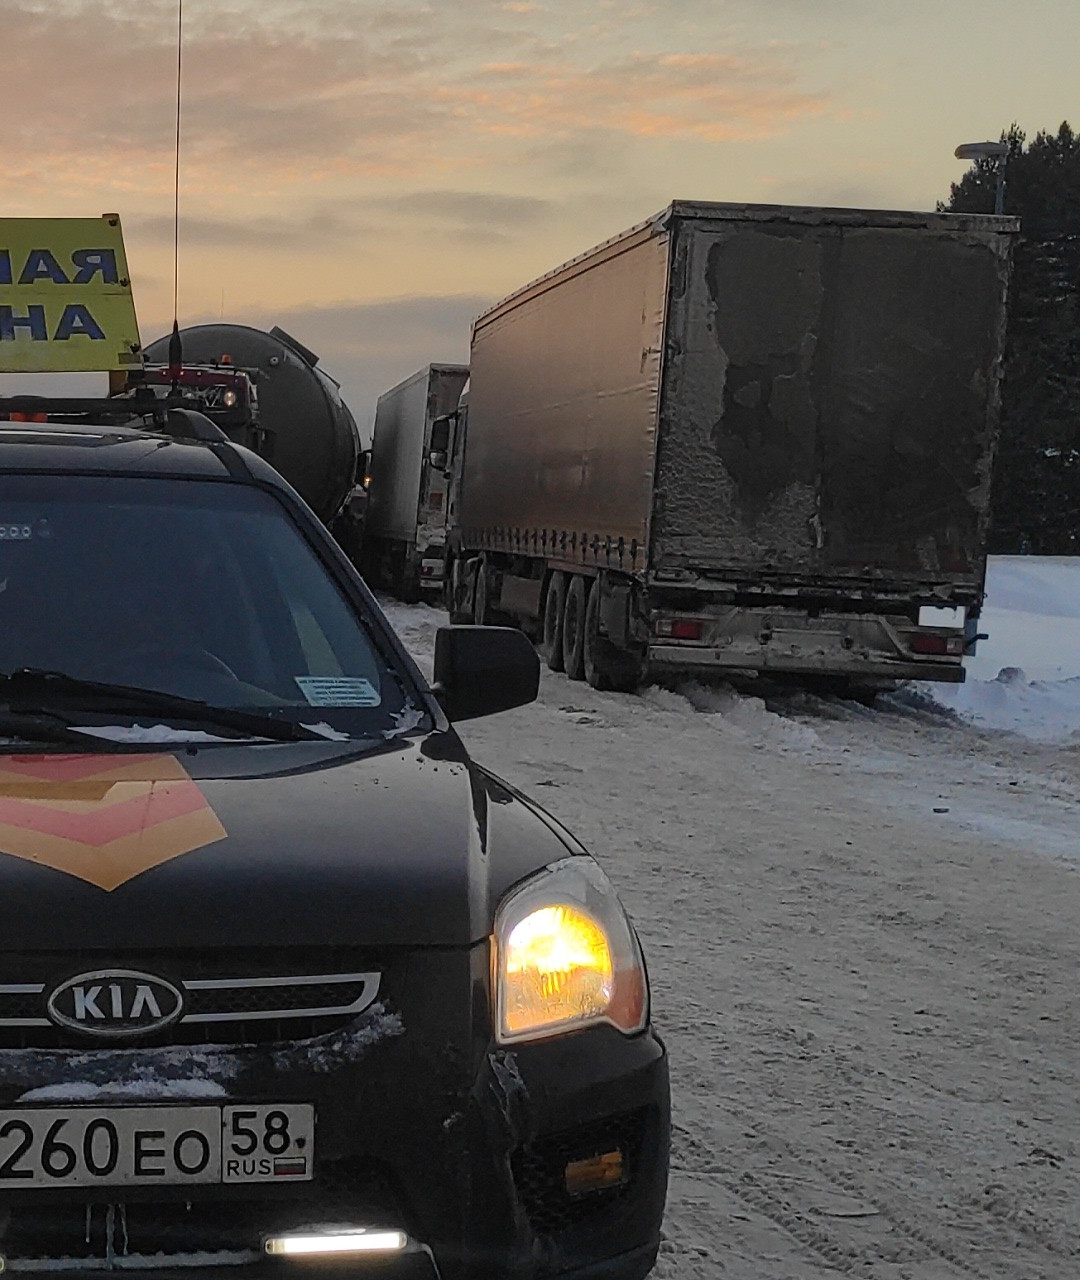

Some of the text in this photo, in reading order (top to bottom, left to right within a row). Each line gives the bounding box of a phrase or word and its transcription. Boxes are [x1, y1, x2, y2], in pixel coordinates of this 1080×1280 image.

[72, 984, 162, 1019] KIA
[231, 1110, 290, 1156] 58
[226, 1158, 272, 1177] RUS
